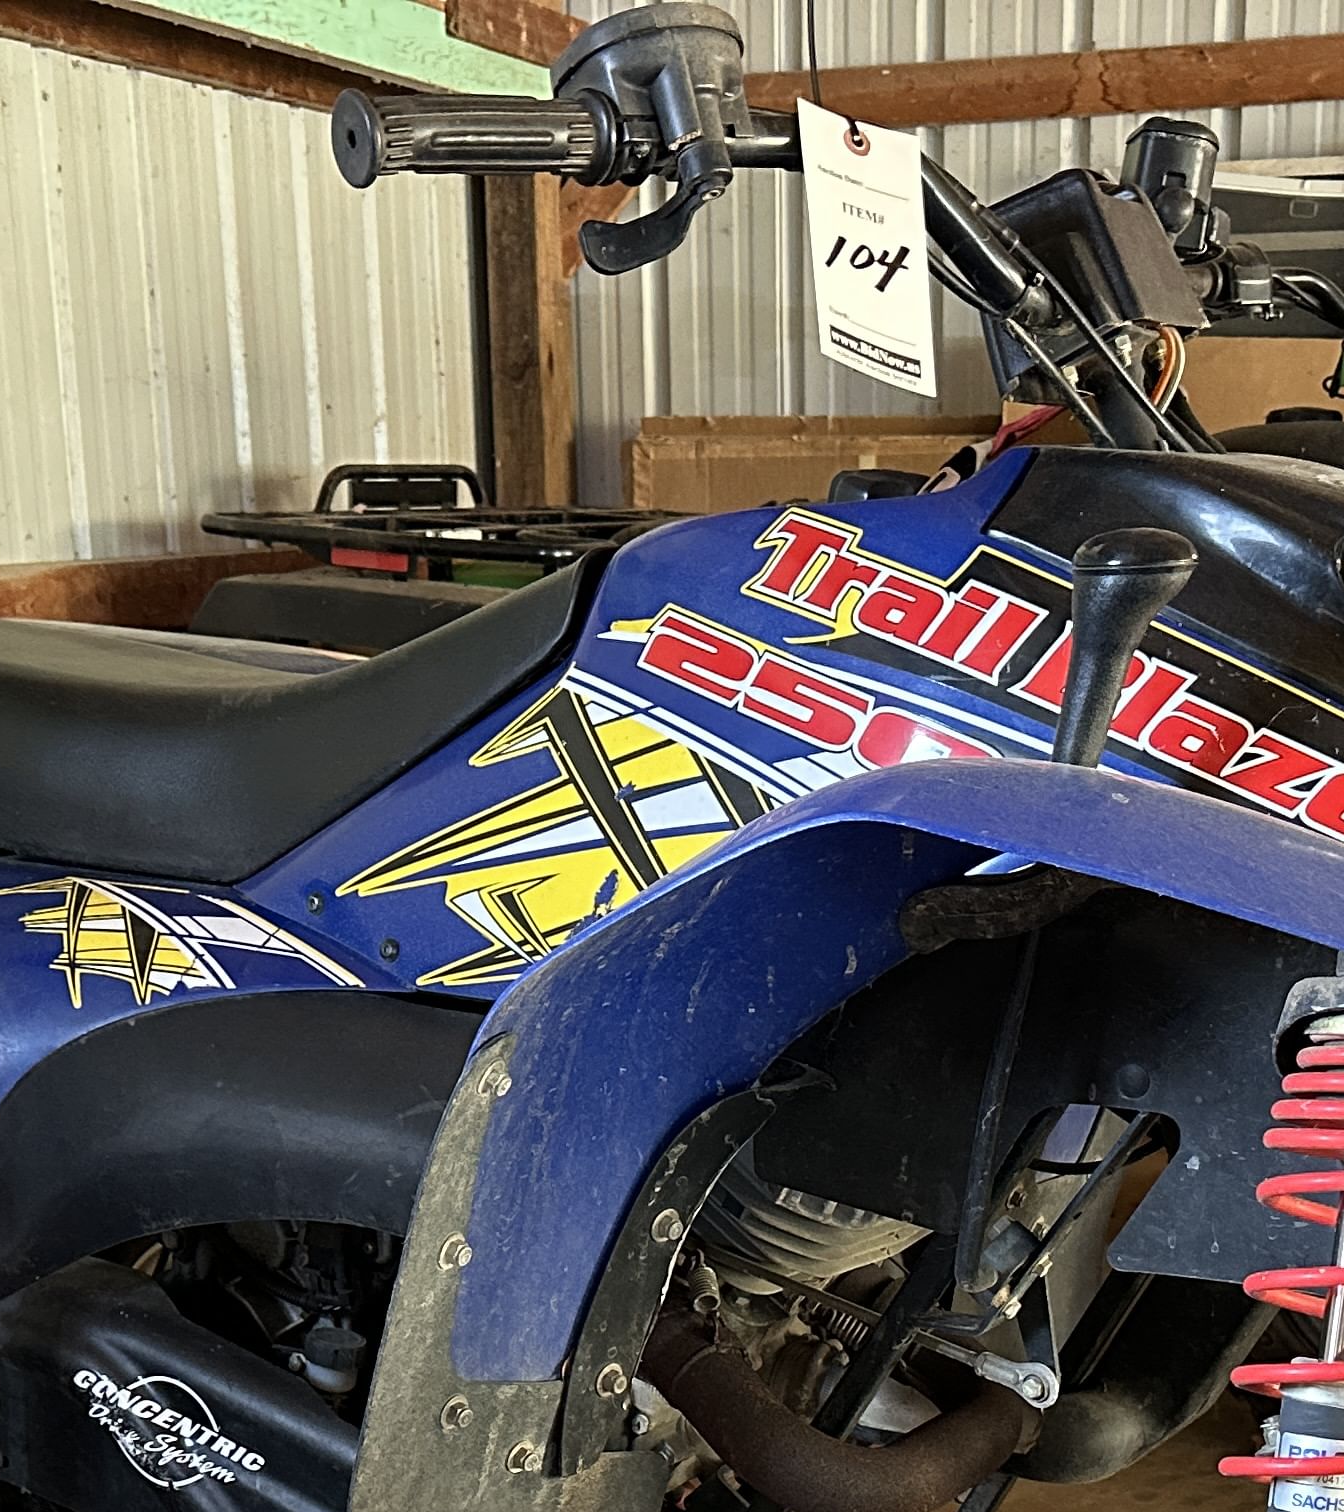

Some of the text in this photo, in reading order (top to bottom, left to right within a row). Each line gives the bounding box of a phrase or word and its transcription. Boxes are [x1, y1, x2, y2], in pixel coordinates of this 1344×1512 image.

[842, 201, 885, 225] ITEM#
[825, 236, 910, 292] 104
[756, 514, 1048, 684] Trail
[639, 611, 1001, 770] 250
[73, 1369, 266, 1472] CONCENTRIC
[144, 1434, 236, 1483] System
